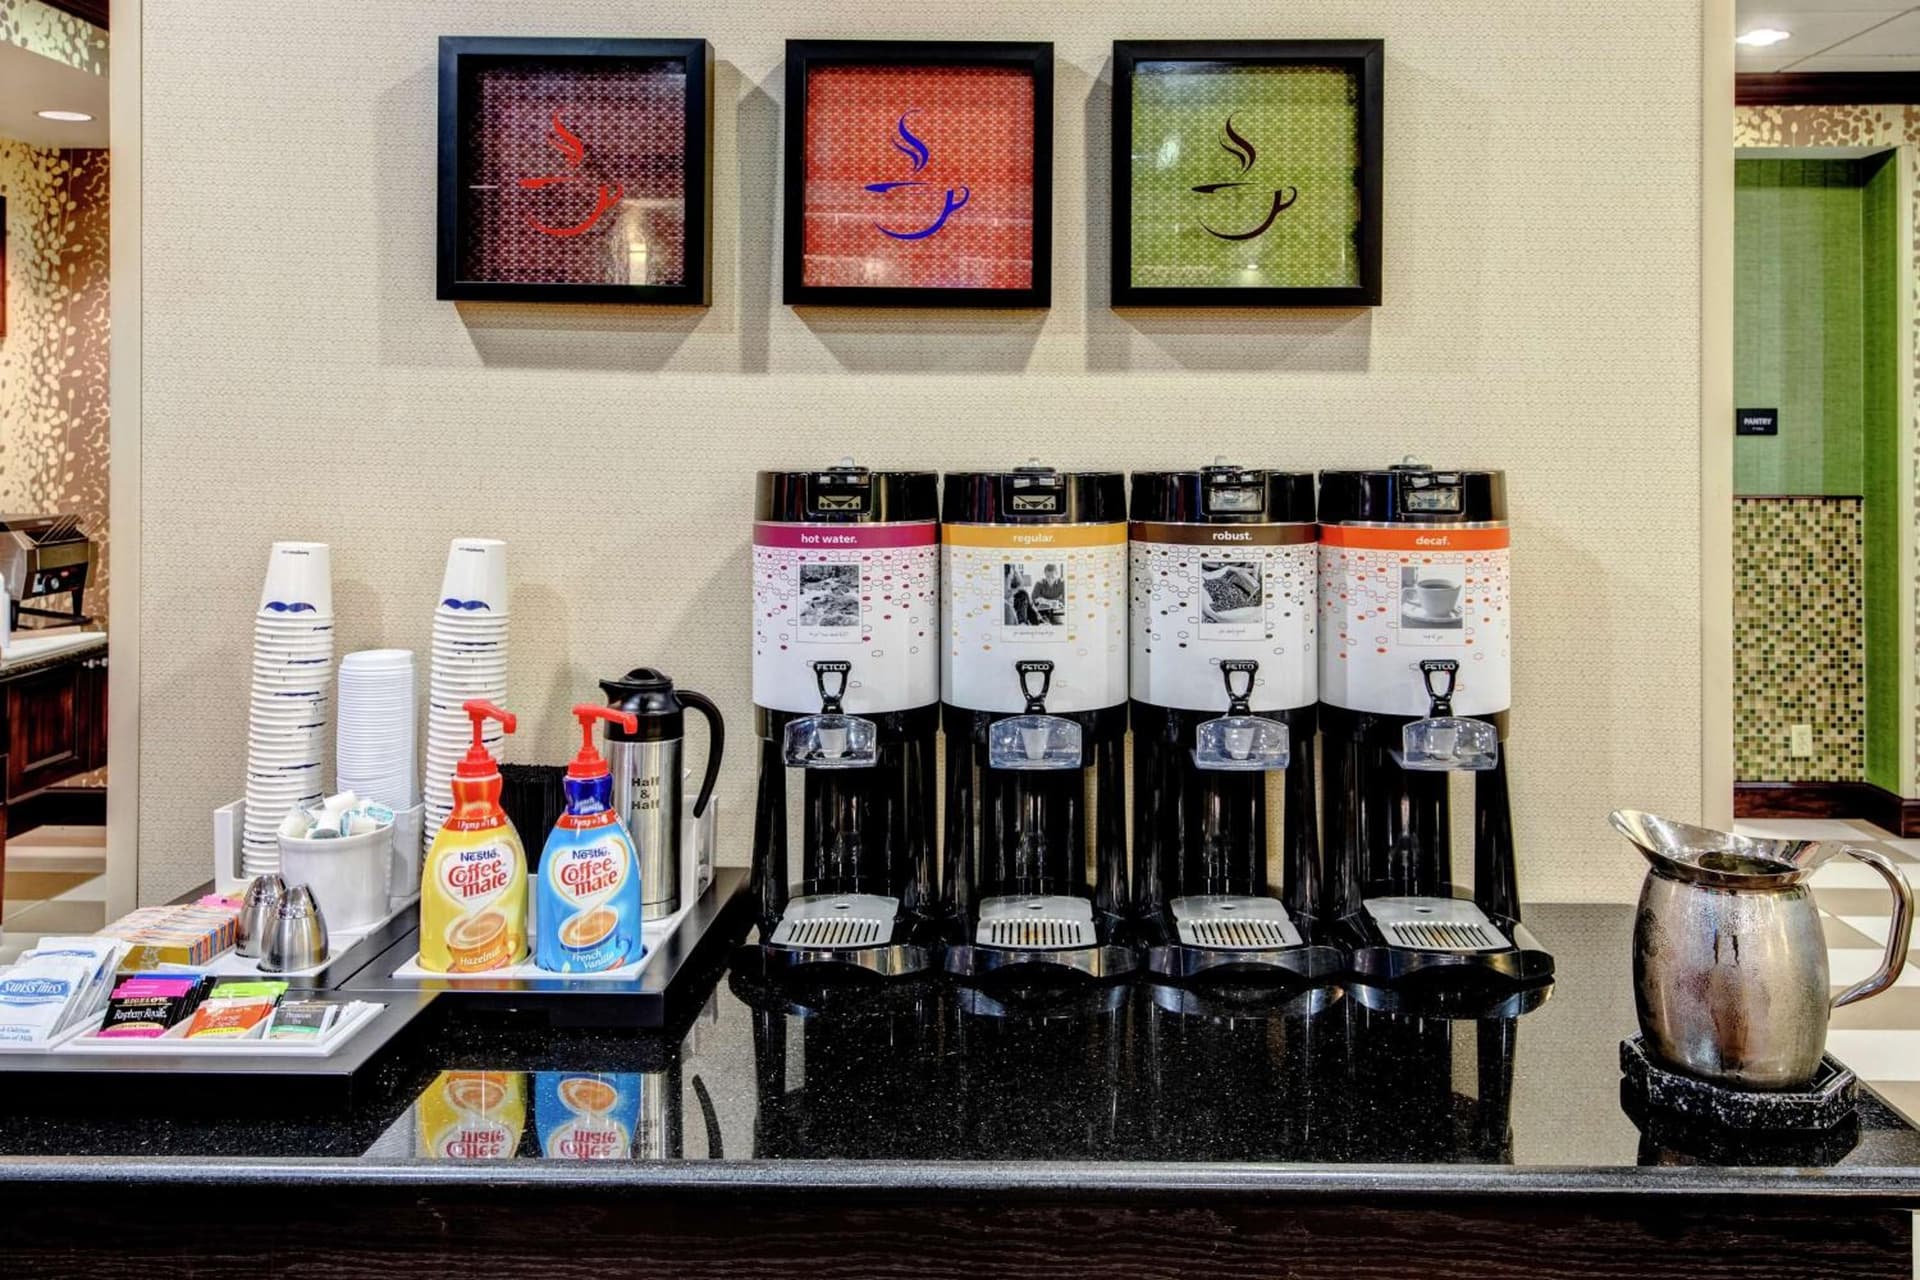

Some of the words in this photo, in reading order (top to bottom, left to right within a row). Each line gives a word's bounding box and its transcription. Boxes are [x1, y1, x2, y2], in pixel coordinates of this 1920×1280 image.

[1743, 417, 1772, 425] PANTRY
[801, 533, 819, 544] hot
[822, 534, 857, 544] water.
[1212, 531, 1252, 541] robust.
[1415, 536, 1450, 546] decaf.
[817, 663, 848, 671] FETCO
[1226, 663, 1254, 671] FETCO
[1424, 663, 1456, 671] FETCO
[632, 777, 660, 787] Half
[640, 789, 650, 799] &
[632, 800, 660, 810] Half
[448, 858, 502, 887] Coffee
[561, 857, 612, 887] Coffee
[463, 872, 507, 898] mate
[574, 869, 618, 897] mate
[571, 949, 602, 962] French
